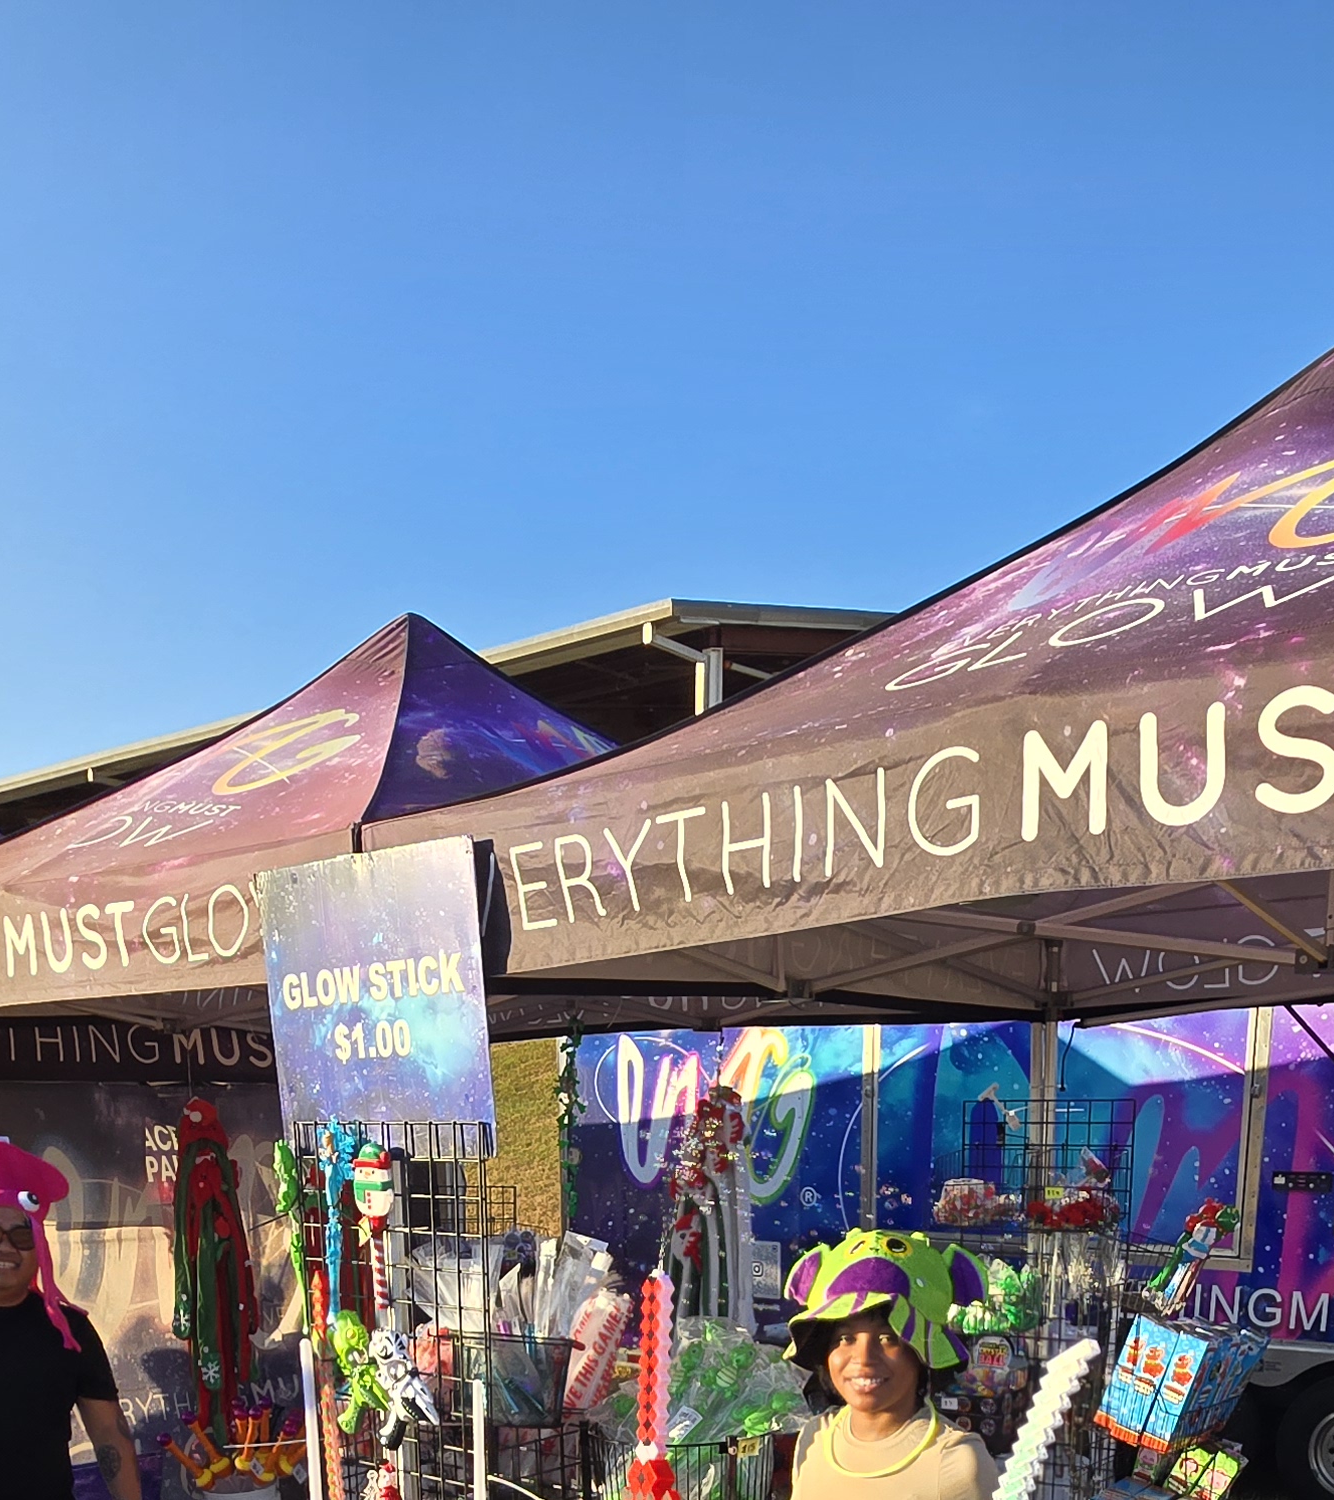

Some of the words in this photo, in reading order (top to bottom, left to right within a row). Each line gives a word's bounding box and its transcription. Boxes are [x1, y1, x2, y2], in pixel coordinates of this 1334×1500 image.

[513, 746, 981, 932] ERYTHING
[3, 900, 135, 977] MUST
[142, 878, 265, 965] GLO
[282, 963, 361, 1011] GLOW
[368, 949, 466, 1001] STICK
[173, 1026, 273, 1068] MUS
[334, 1018, 411, 1065] $1.00
